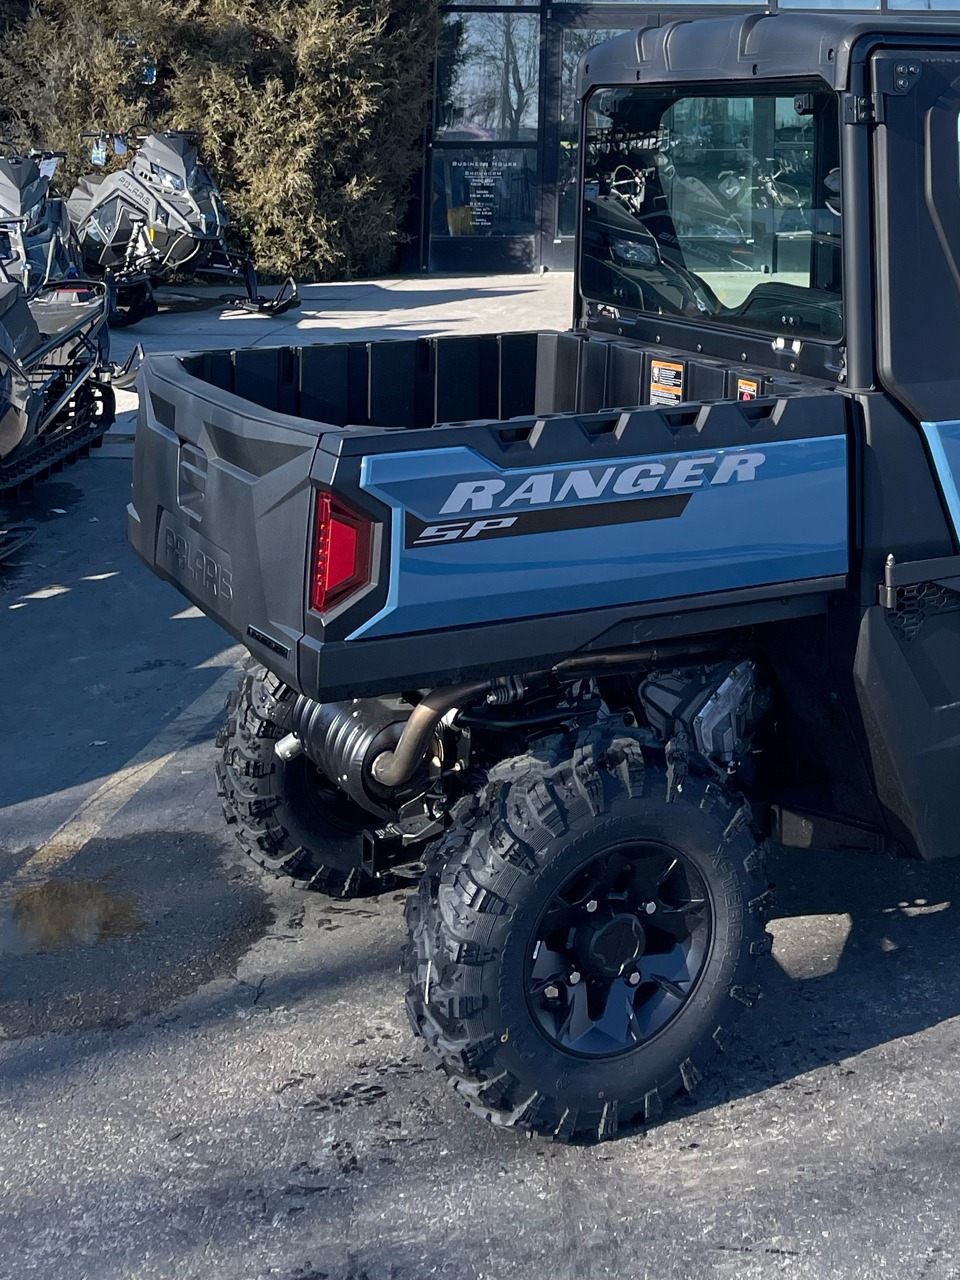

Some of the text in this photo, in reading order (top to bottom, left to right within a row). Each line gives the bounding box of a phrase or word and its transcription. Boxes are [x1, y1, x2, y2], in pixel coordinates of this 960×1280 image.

[117, 176, 151, 205] POLARIS
[438, 453, 766, 515] RANGER
[412, 517, 518, 545] SP
[165, 526, 233, 600] POLARIS
